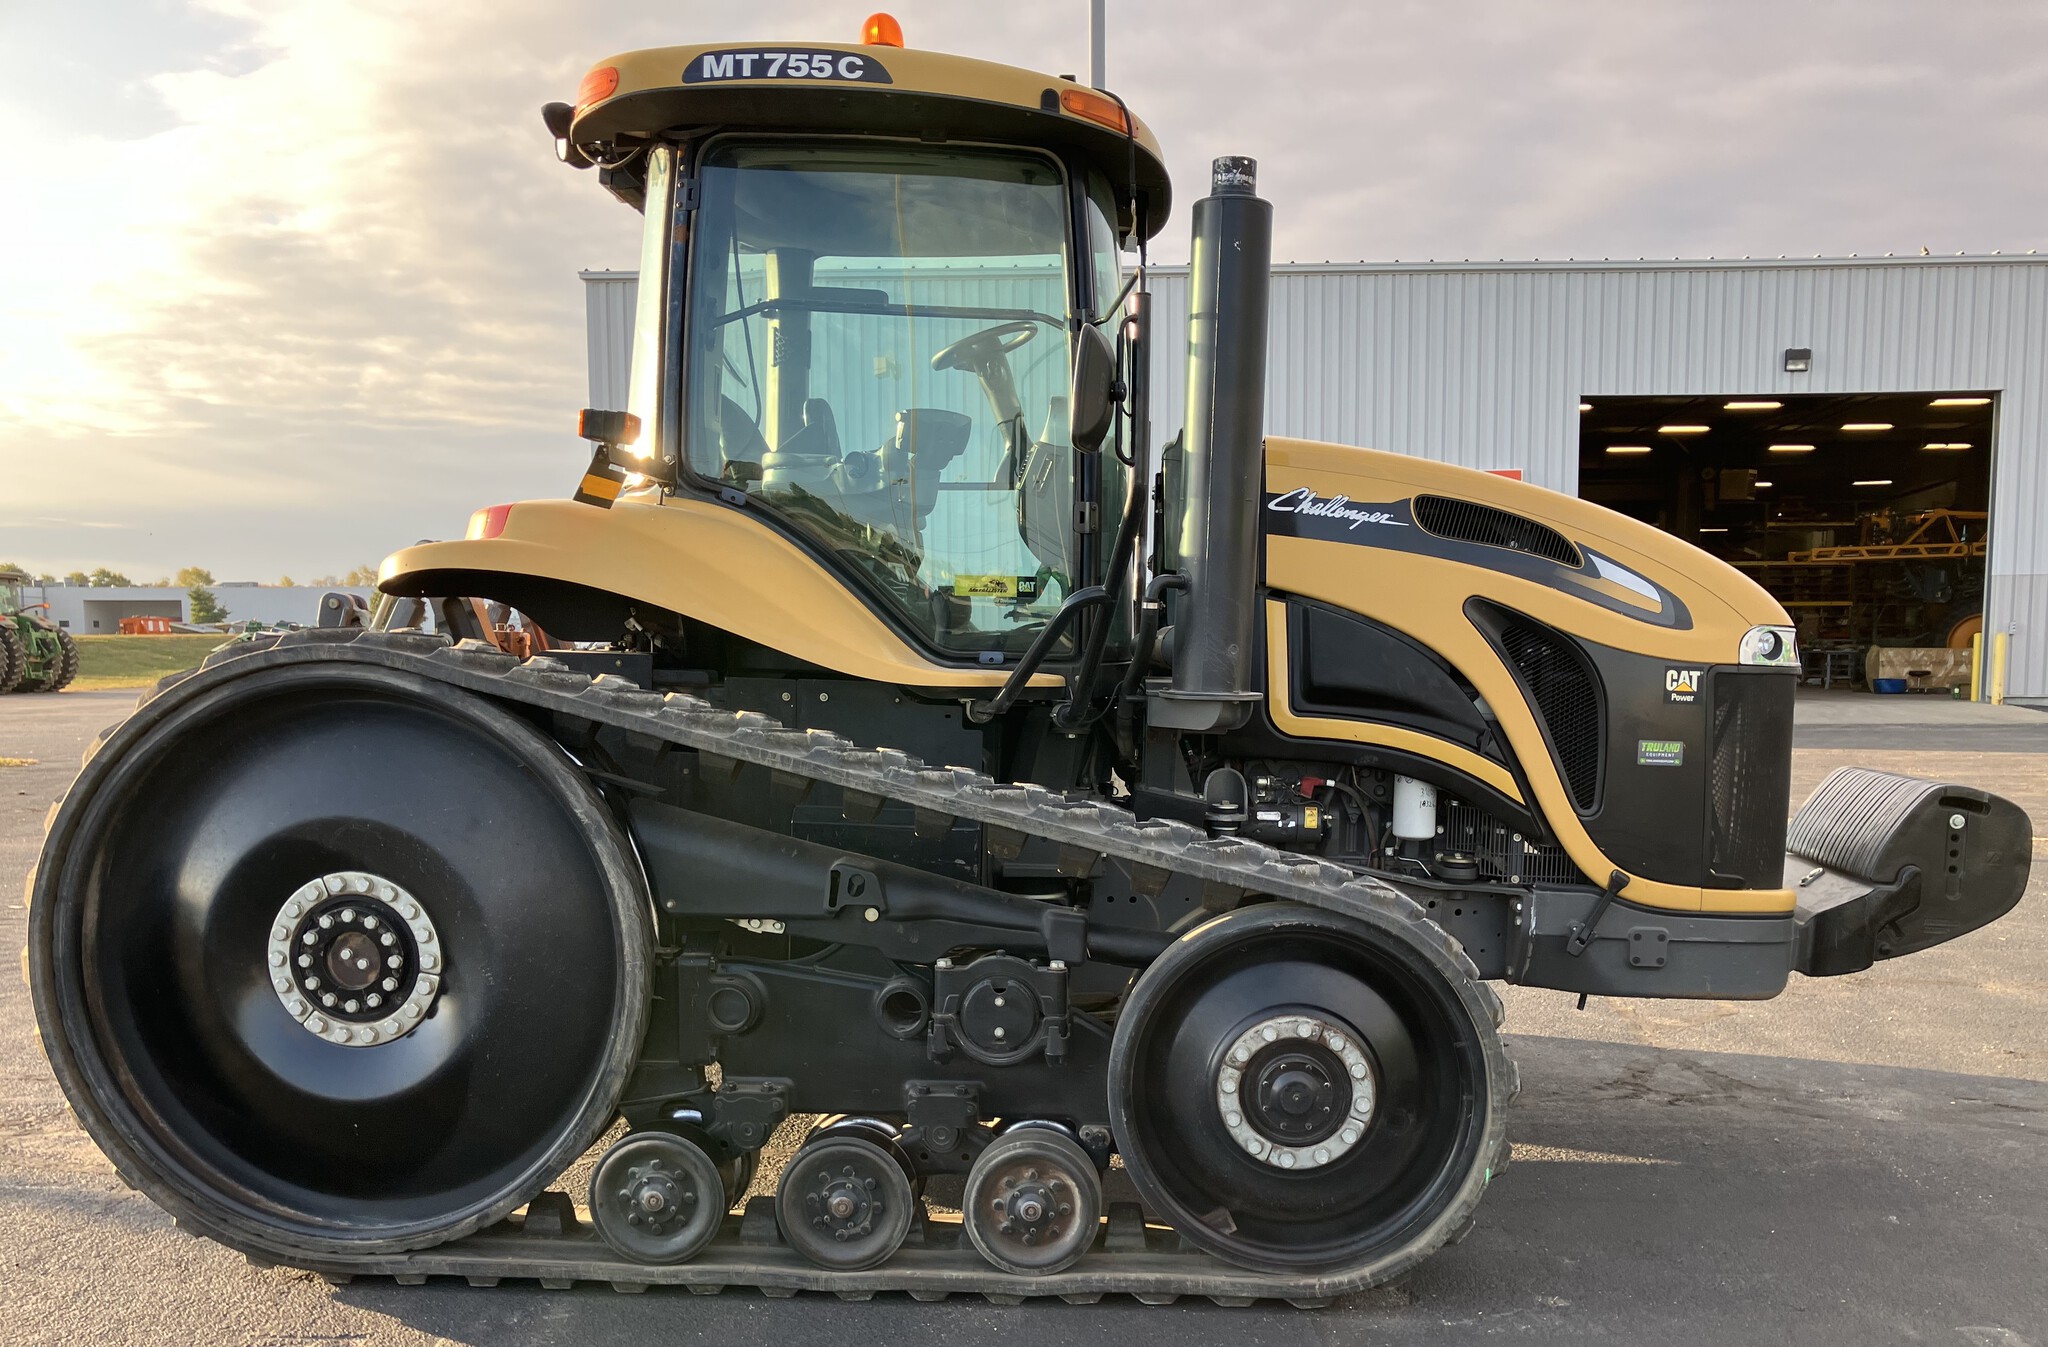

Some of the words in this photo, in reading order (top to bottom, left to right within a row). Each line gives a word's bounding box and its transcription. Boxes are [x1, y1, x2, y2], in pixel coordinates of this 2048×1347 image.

[1267, 487, 1409, 530] Challenger
[1018, 581, 1035, 592] CAT
[1665, 669, 1701, 692] CAT
[1671, 693, 1694, 702] Power
[1641, 742, 1680, 753] TRULAND
